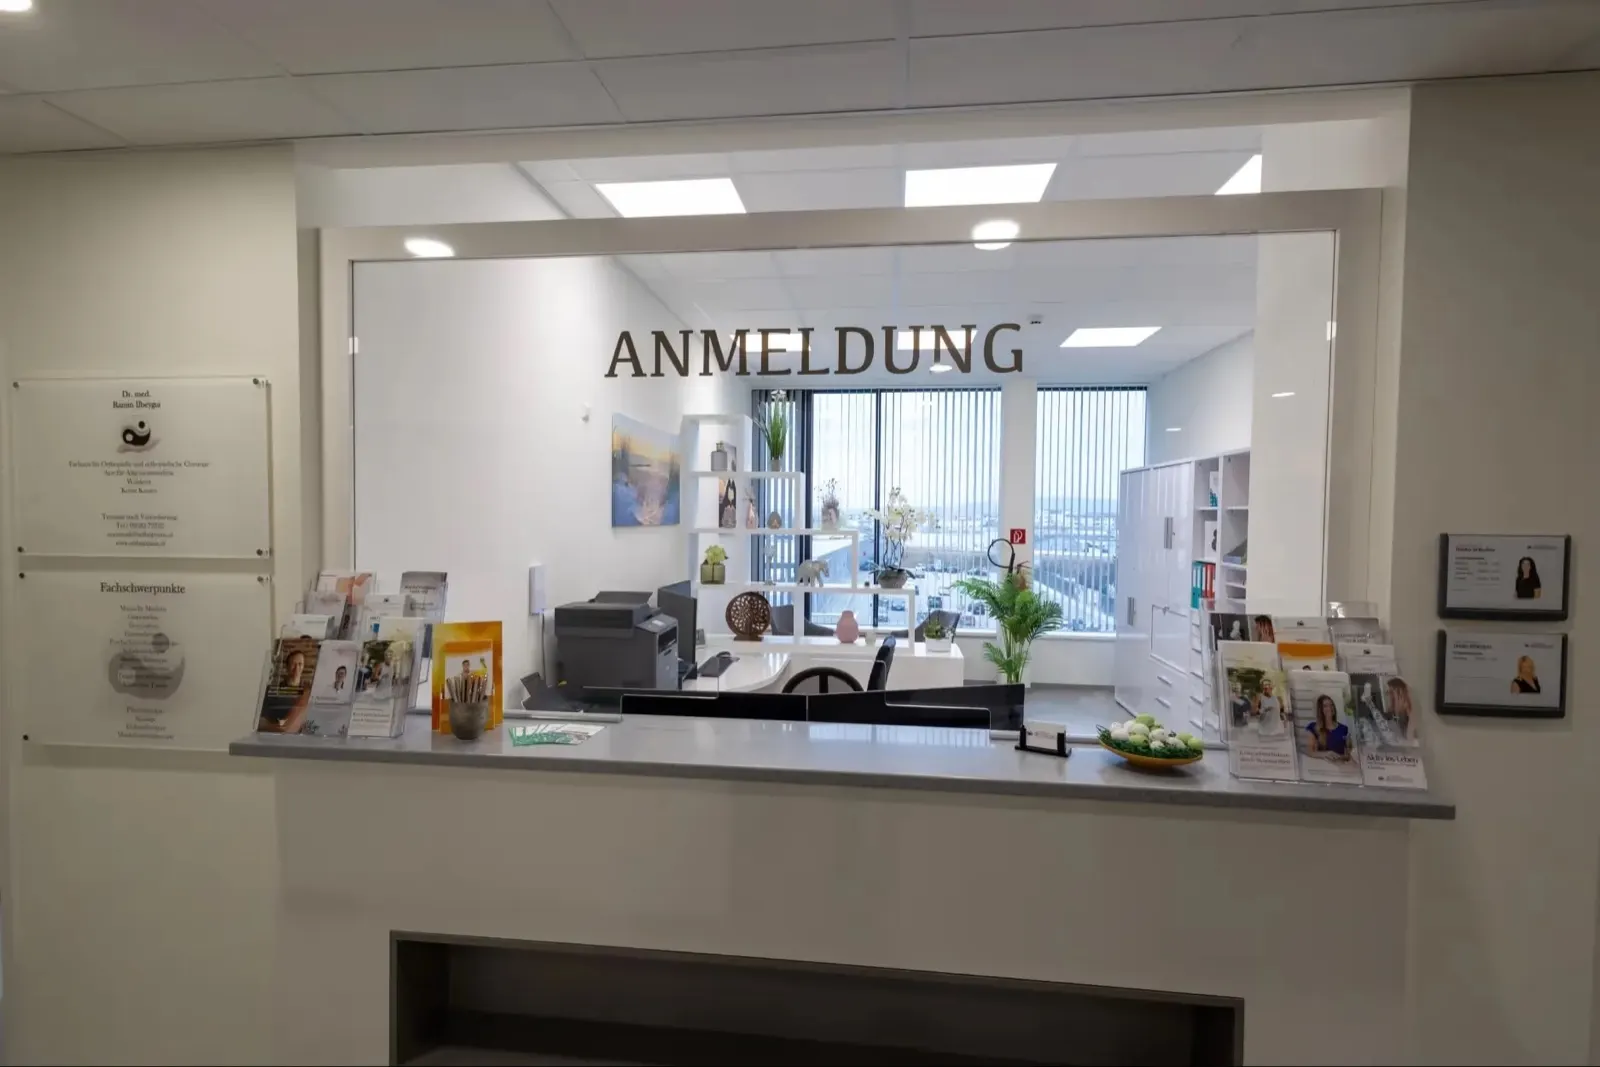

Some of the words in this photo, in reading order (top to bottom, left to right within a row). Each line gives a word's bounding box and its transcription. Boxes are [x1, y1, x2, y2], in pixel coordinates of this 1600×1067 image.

[604, 322, 1024, 378] ANMELDUNG
[122, 390, 133, 398] Dr.
[134, 390, 151, 398] med.
[100, 582, 186, 595] Fachschwerpunkte
